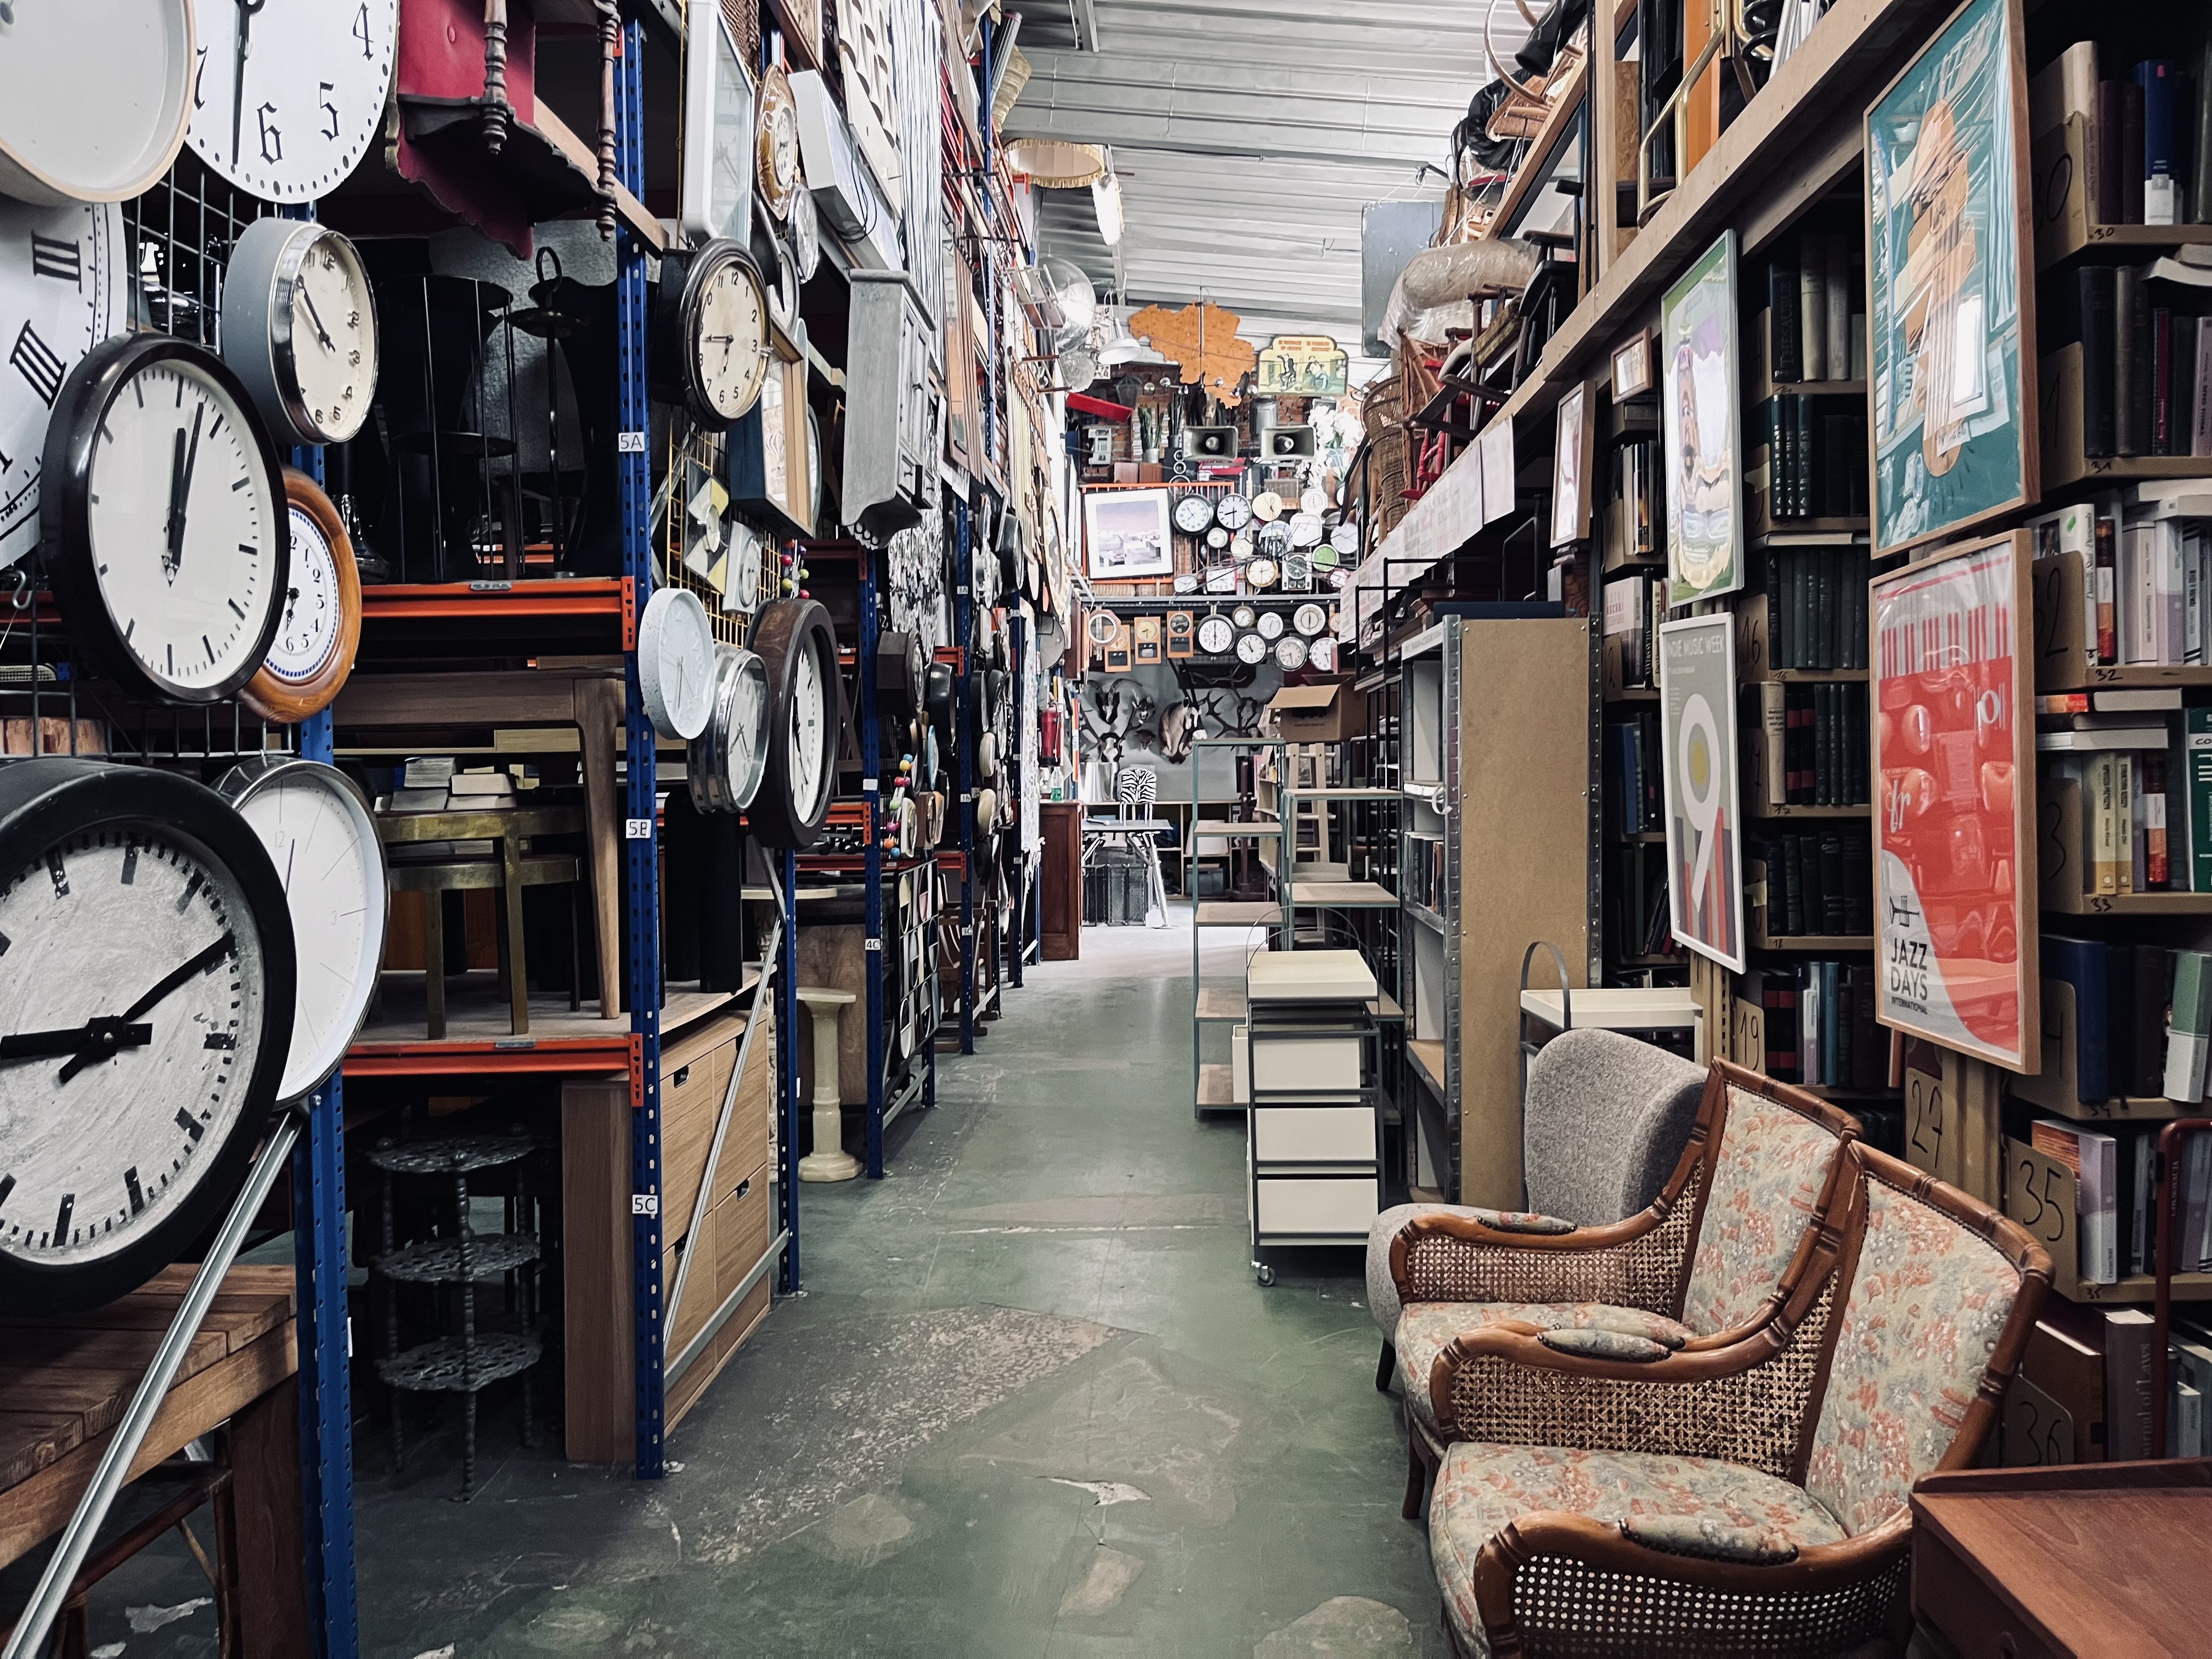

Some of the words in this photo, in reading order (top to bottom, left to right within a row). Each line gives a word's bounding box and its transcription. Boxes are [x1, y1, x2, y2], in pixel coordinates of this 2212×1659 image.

[353, 2, 374, 60] 4
[319, 81, 339, 141] 5
[257, 101, 283, 165] 6
[1780, 281, 1795, 368] THESAURUS
[315, 409, 323, 424] 6
[333, 405, 341, 420] 5
[620, 435, 642, 449] 5A
[1666, 640, 1682, 658] NDIE
[1705, 633, 1725, 653] WEEK
[1743, 615, 1760, 664] 16
[2095, 669, 2123, 681] 32
[275, 831, 285, 849] 12
[2091, 898, 2112, 911] 33
[866, 940, 880, 949] 4C
[1891, 932, 1927, 971] JAZZ
[1891, 966, 1928, 1001] DAYS
[1891, 996, 1928, 1015] INTERNATIONAL
[1740, 1011, 1759, 1071] 19
[634, 1197, 656, 1212] 5C
[2019, 1160, 2064, 1242] 35
[2137, 1343, 2151, 1385] Laws
[2137, 1388, 2152, 1407] of
